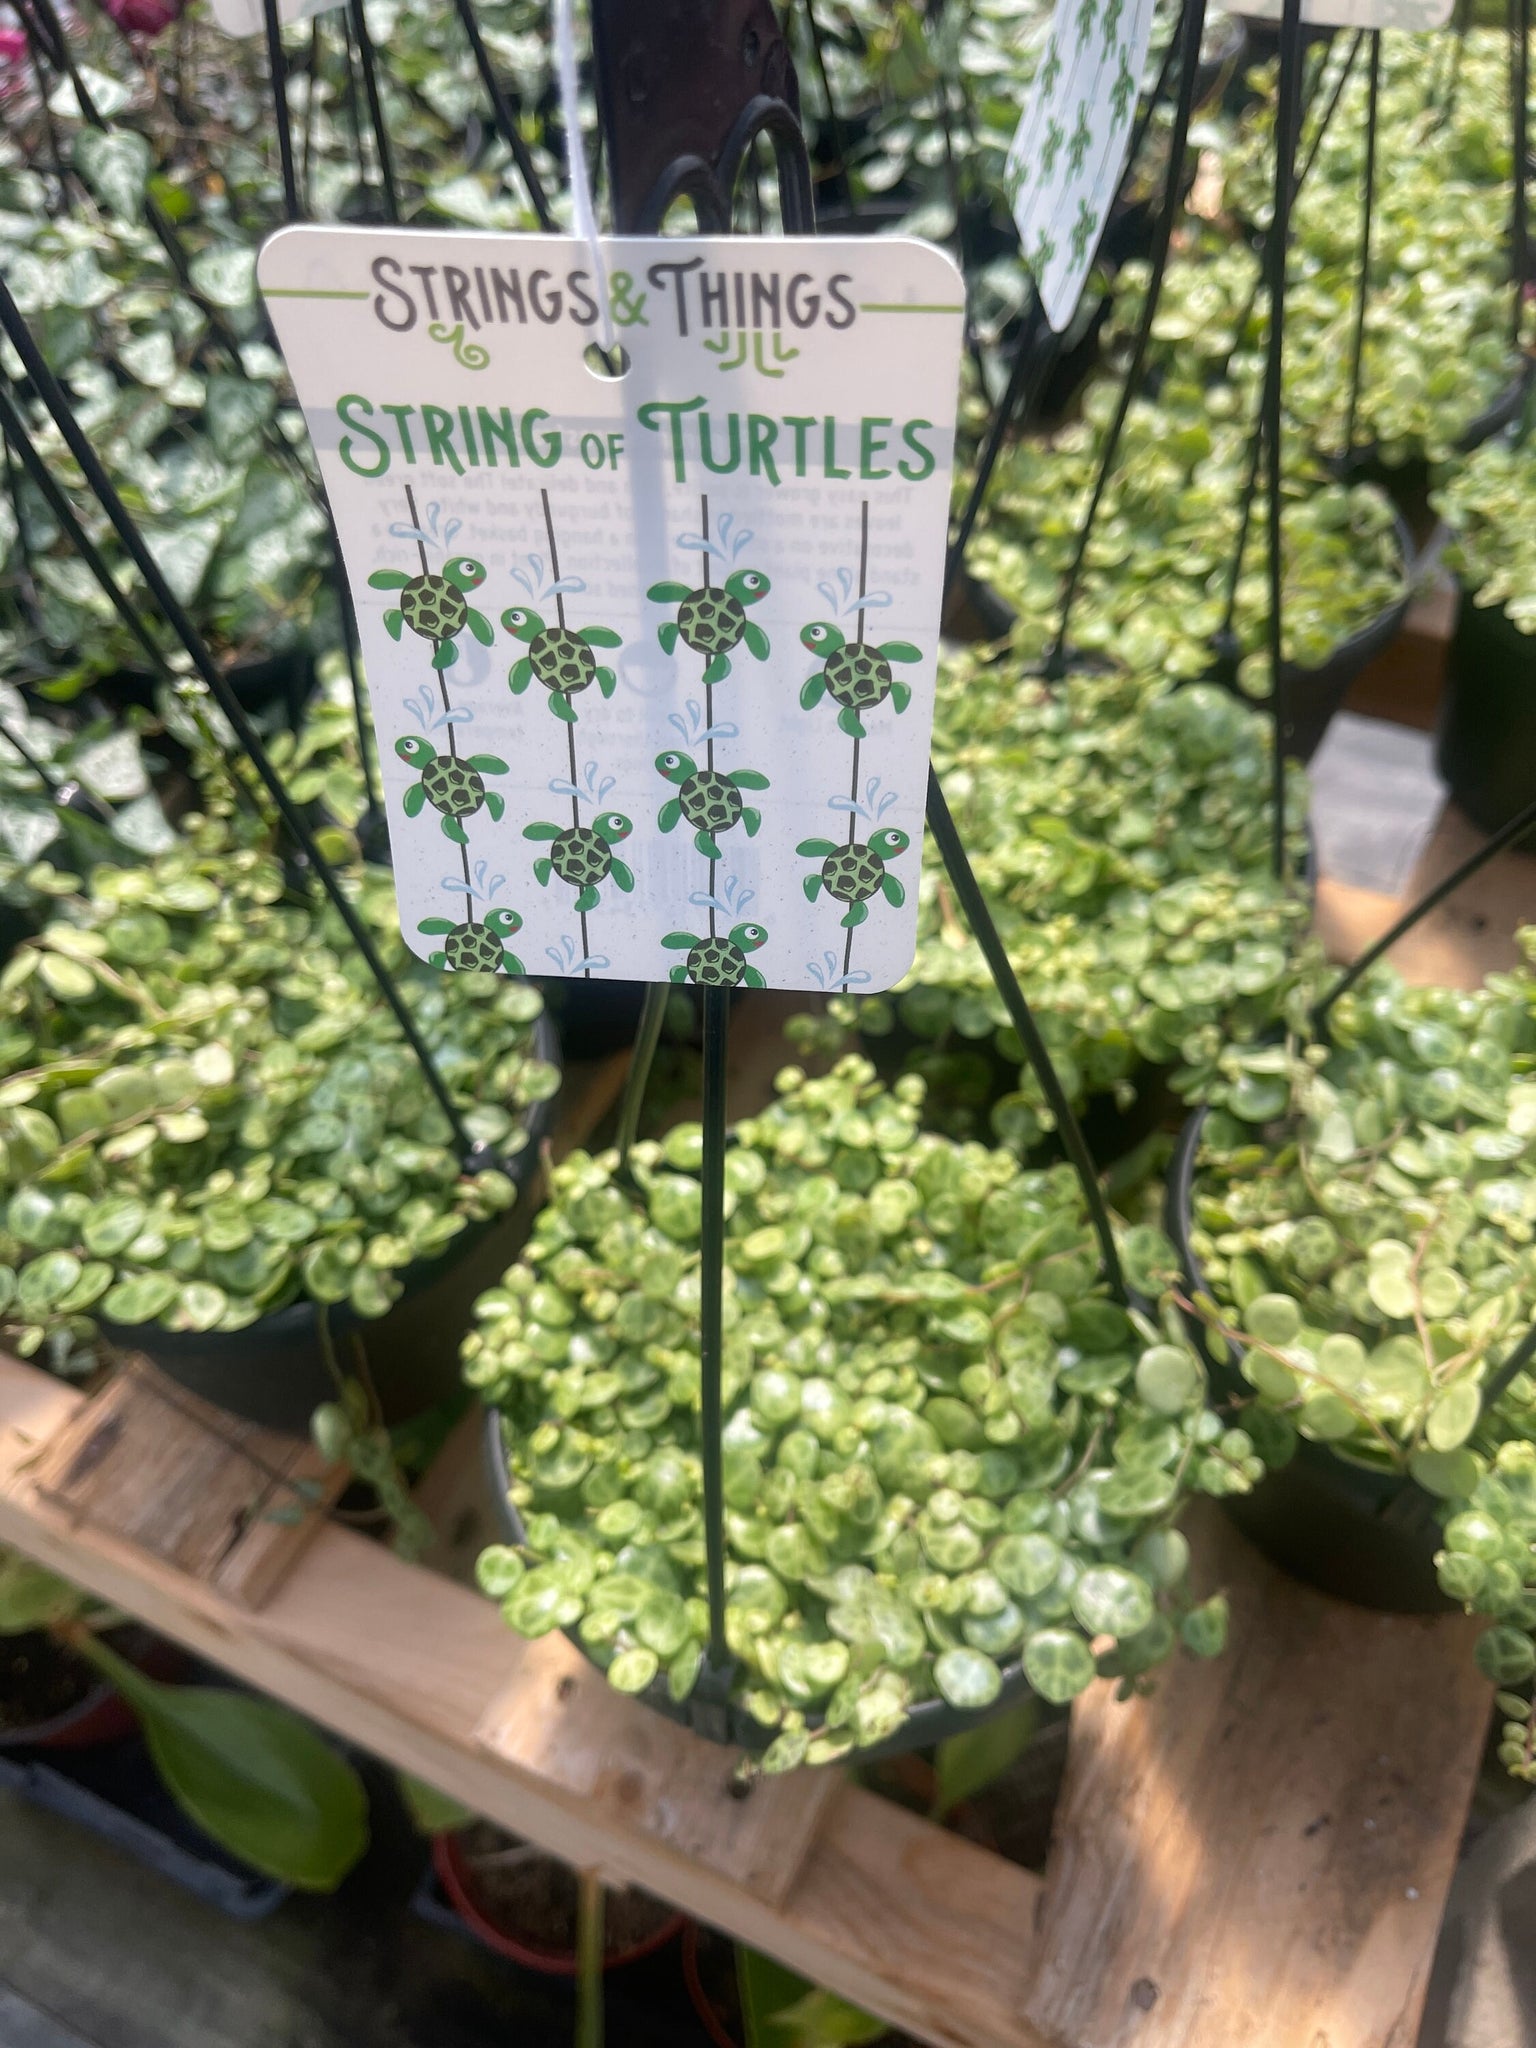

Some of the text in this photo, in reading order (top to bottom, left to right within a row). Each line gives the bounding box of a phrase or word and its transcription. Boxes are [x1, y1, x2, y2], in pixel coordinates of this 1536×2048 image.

[372, 257, 856, 337] STRINGS & THINGS
[335, 394, 935, 487] STRING OF TURTLES
